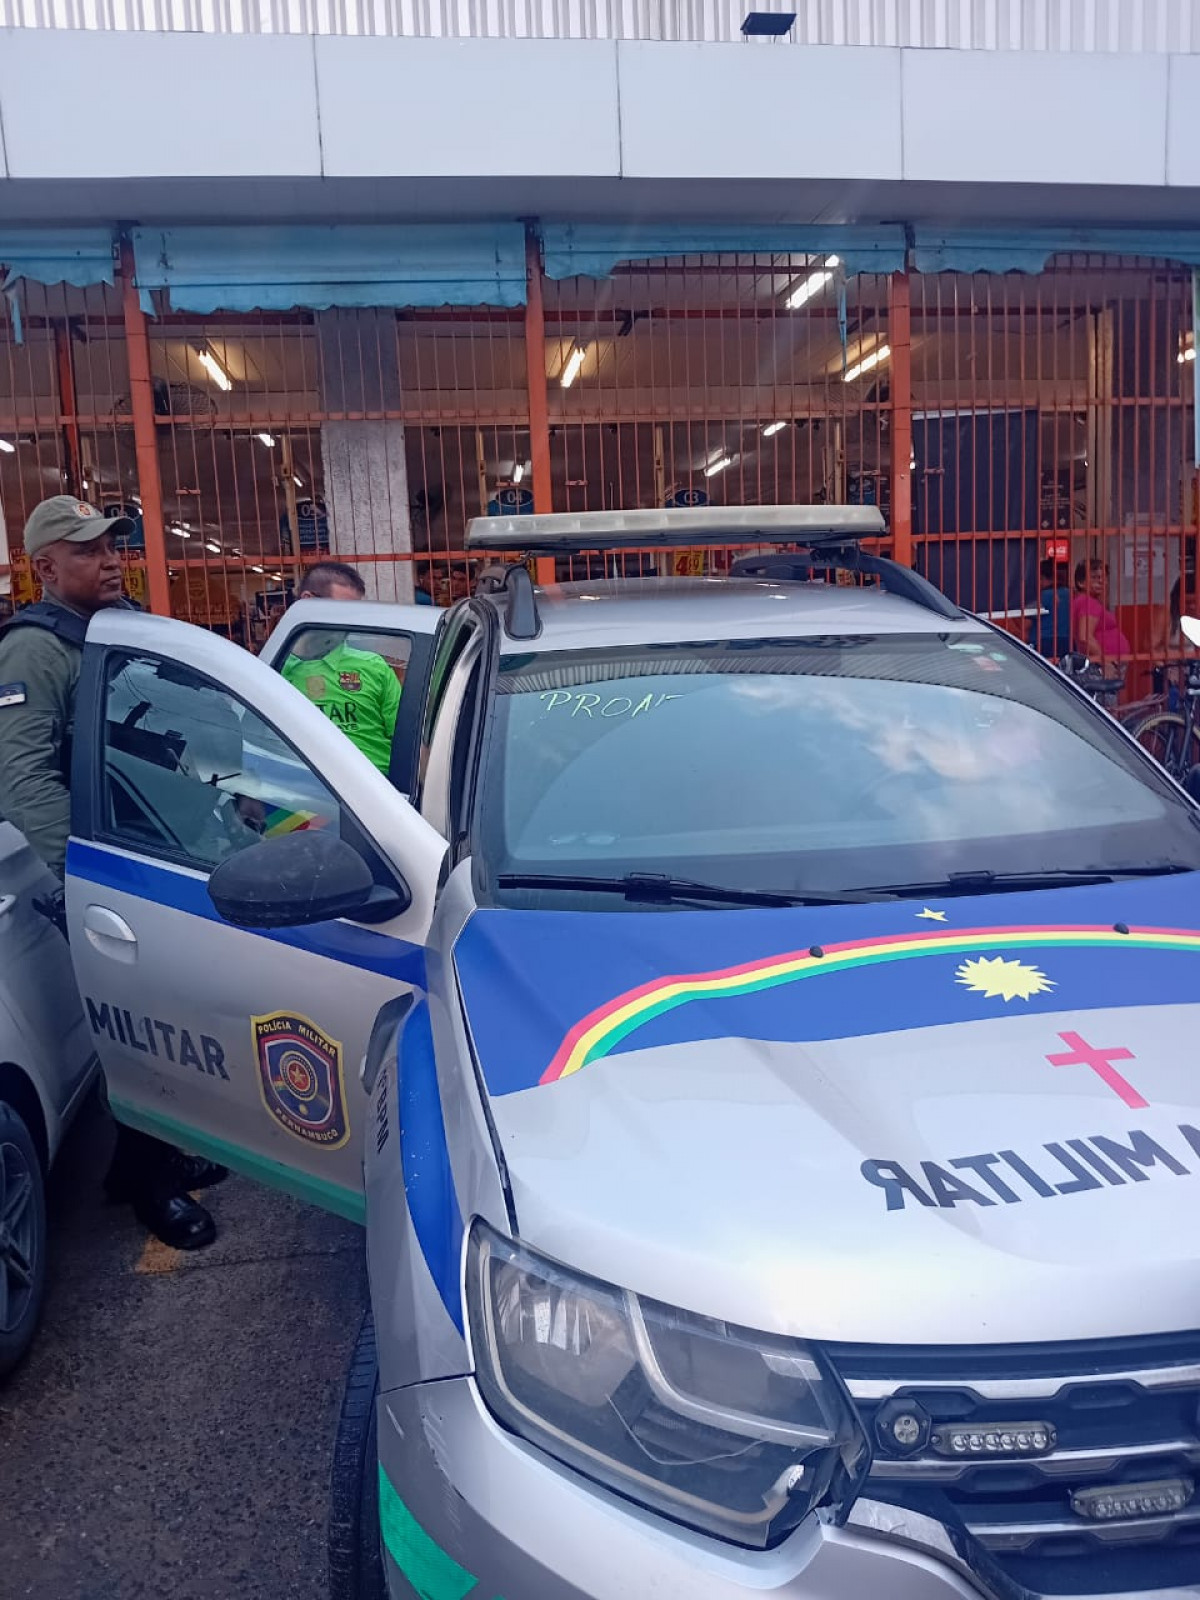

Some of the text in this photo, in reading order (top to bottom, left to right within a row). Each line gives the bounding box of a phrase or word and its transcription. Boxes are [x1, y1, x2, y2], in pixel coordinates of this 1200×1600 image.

[85, 997, 231, 1081] MILITAR
[298, 1024, 337, 1058] MILITAR
[275, 1107, 340, 1141] PERNAMBUCO
